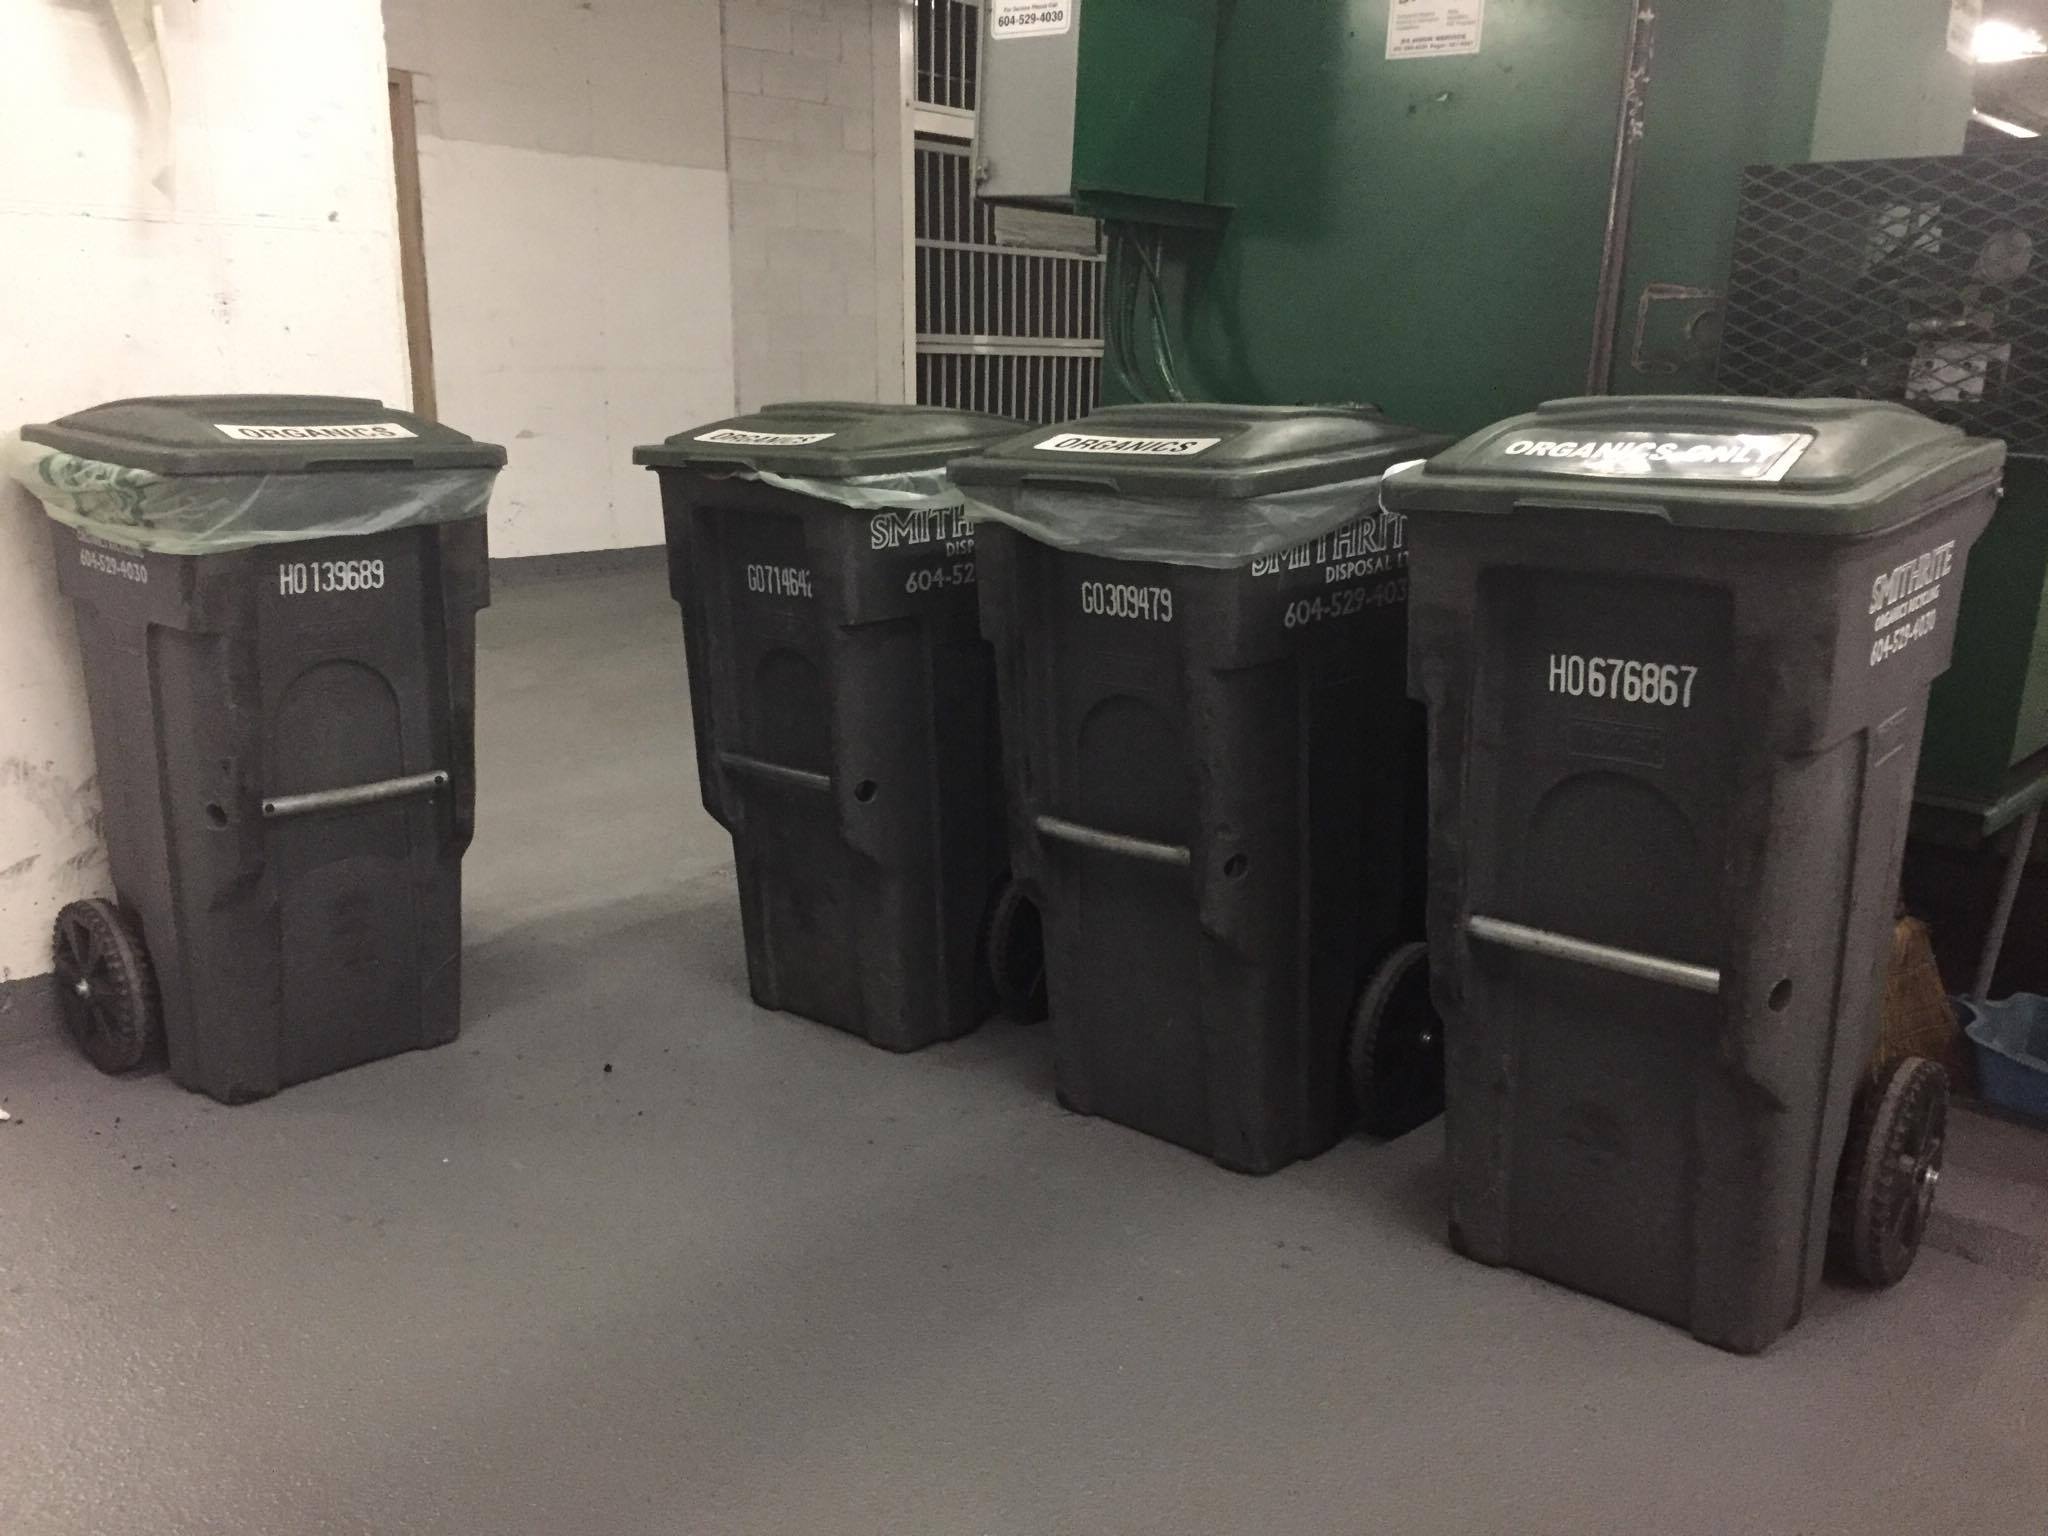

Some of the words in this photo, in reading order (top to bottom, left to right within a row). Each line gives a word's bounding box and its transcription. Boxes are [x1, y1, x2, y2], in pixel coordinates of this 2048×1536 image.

[998, 10, 1064, 27] 604-529-4030
[237, 426, 397, 438] ORGANICS
[1054, 437, 1198, 452] ORGANICS
[905, 561, 976, 594] 604-52
[1325, 554, 1394, 584] DISPOSAL
